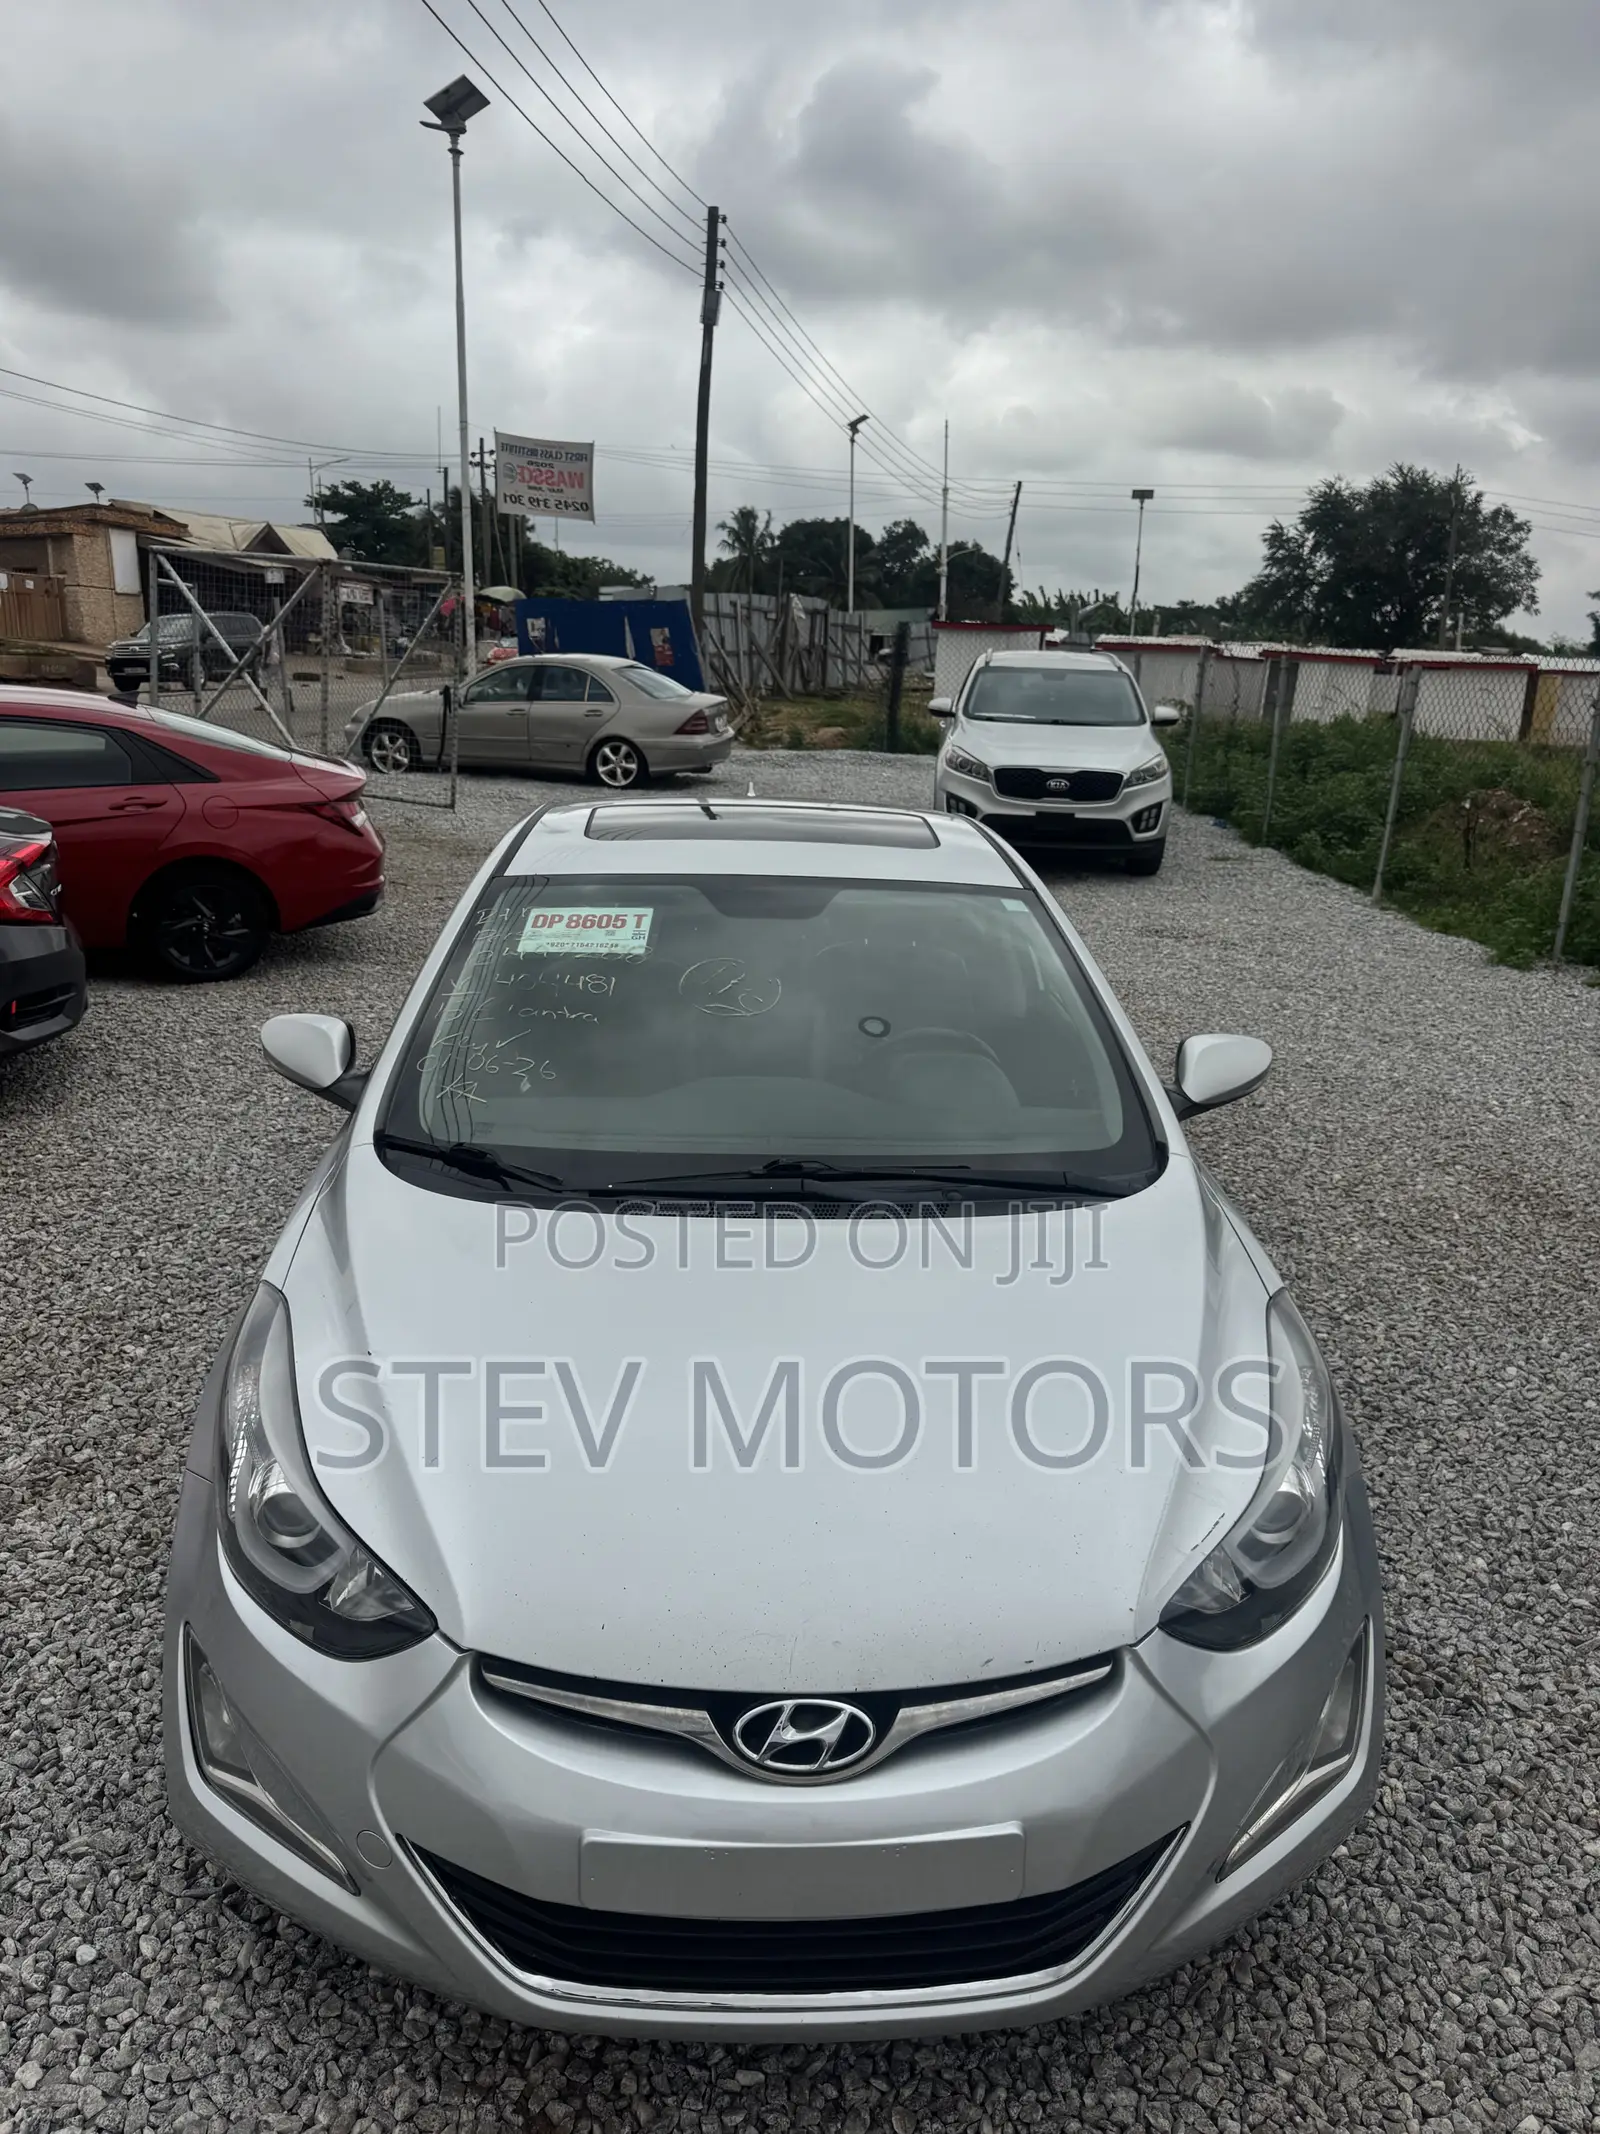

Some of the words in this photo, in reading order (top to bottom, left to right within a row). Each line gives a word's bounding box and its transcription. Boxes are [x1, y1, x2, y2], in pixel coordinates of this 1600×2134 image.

[531, 913, 564, 929] DP
[565, 913, 628, 929] 8605
[633, 914, 648, 929] T
